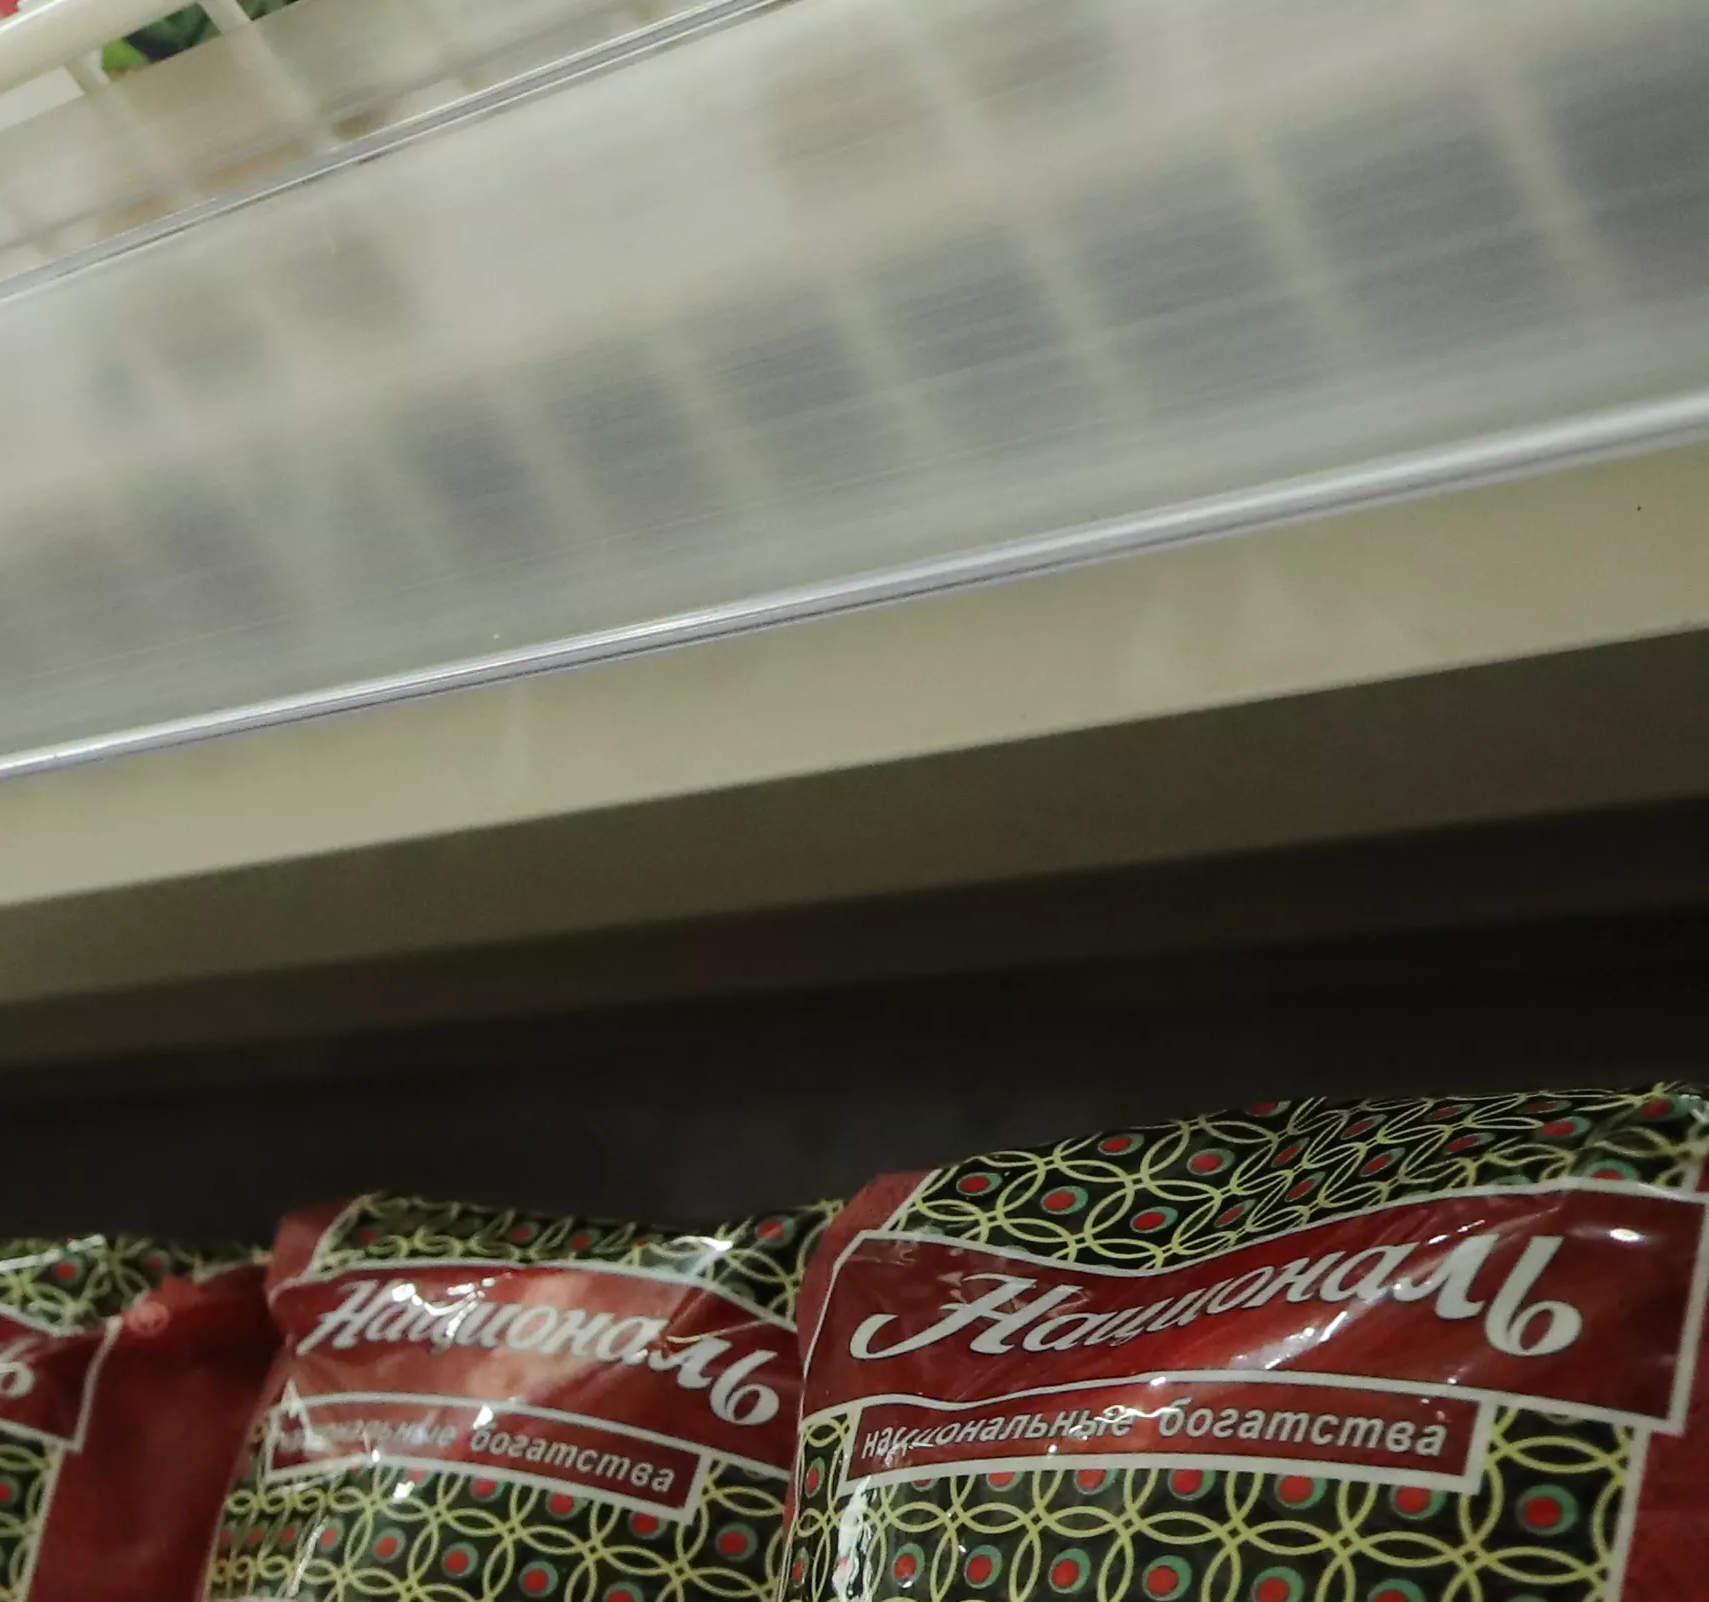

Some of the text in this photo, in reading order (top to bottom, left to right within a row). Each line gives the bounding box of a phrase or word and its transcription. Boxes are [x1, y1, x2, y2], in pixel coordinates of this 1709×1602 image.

[849, 1231, 1582, 1360] Националь
[469, 1415, 676, 1496] богатства
[1158, 1397, 1448, 1458] богатства
